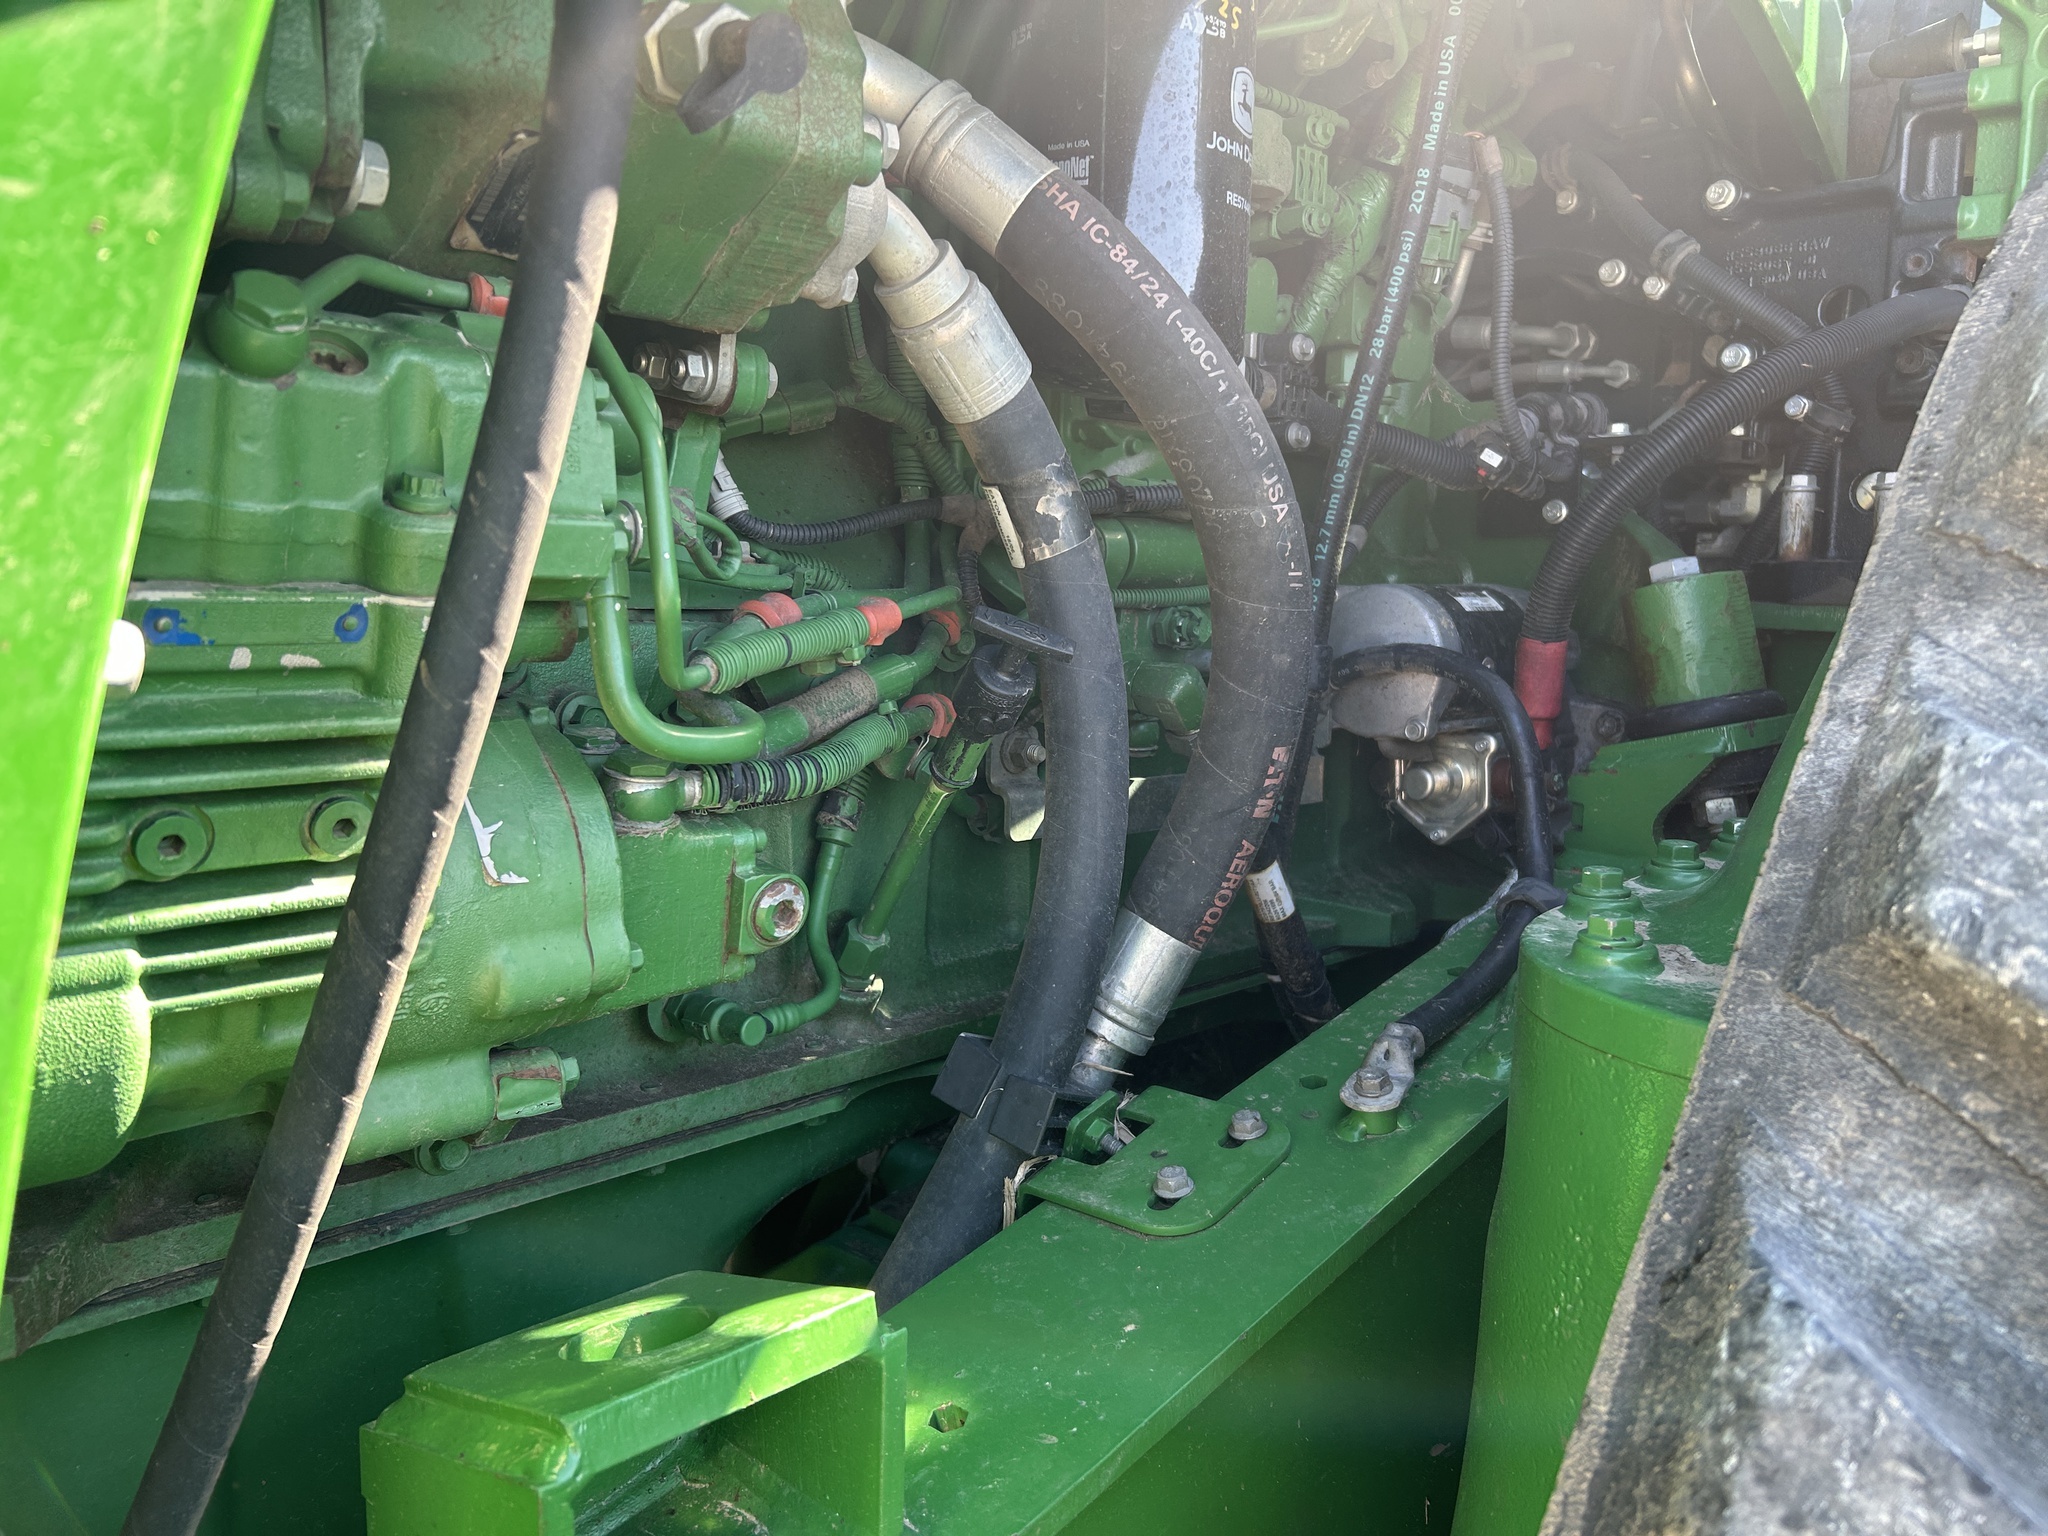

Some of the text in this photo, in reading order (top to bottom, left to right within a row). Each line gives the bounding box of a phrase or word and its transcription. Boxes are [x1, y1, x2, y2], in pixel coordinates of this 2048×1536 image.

[1437, 34, 1457, 75] USA
[1434, 79, 1448, 98] in
[1423, 100, 1444, 151] Made
[1047, 140, 1090, 151] Made in USA
[1206, 131, 1243, 160] JOHN
[1408, 167, 1430, 214] 2Q18
[1398, 230, 1416, 263] psi)
[1383, 264, 1405, 302] (400
[1376, 305, 1393, 335] bar
[1369, 337, 1385, 359] 28
[1081, 216, 1169, 309] IC-84/24
[1262, 462, 1289, 524] USA
[1351, 373, 1375, 421] DN12
[1343, 423, 1360, 447] in)
[1330, 449, 1352, 489] (0.50
[987, 489, 1002, 516] EATON
[1324, 491, 1341, 525] mm
[1314, 527, 1332, 561] 12.7
